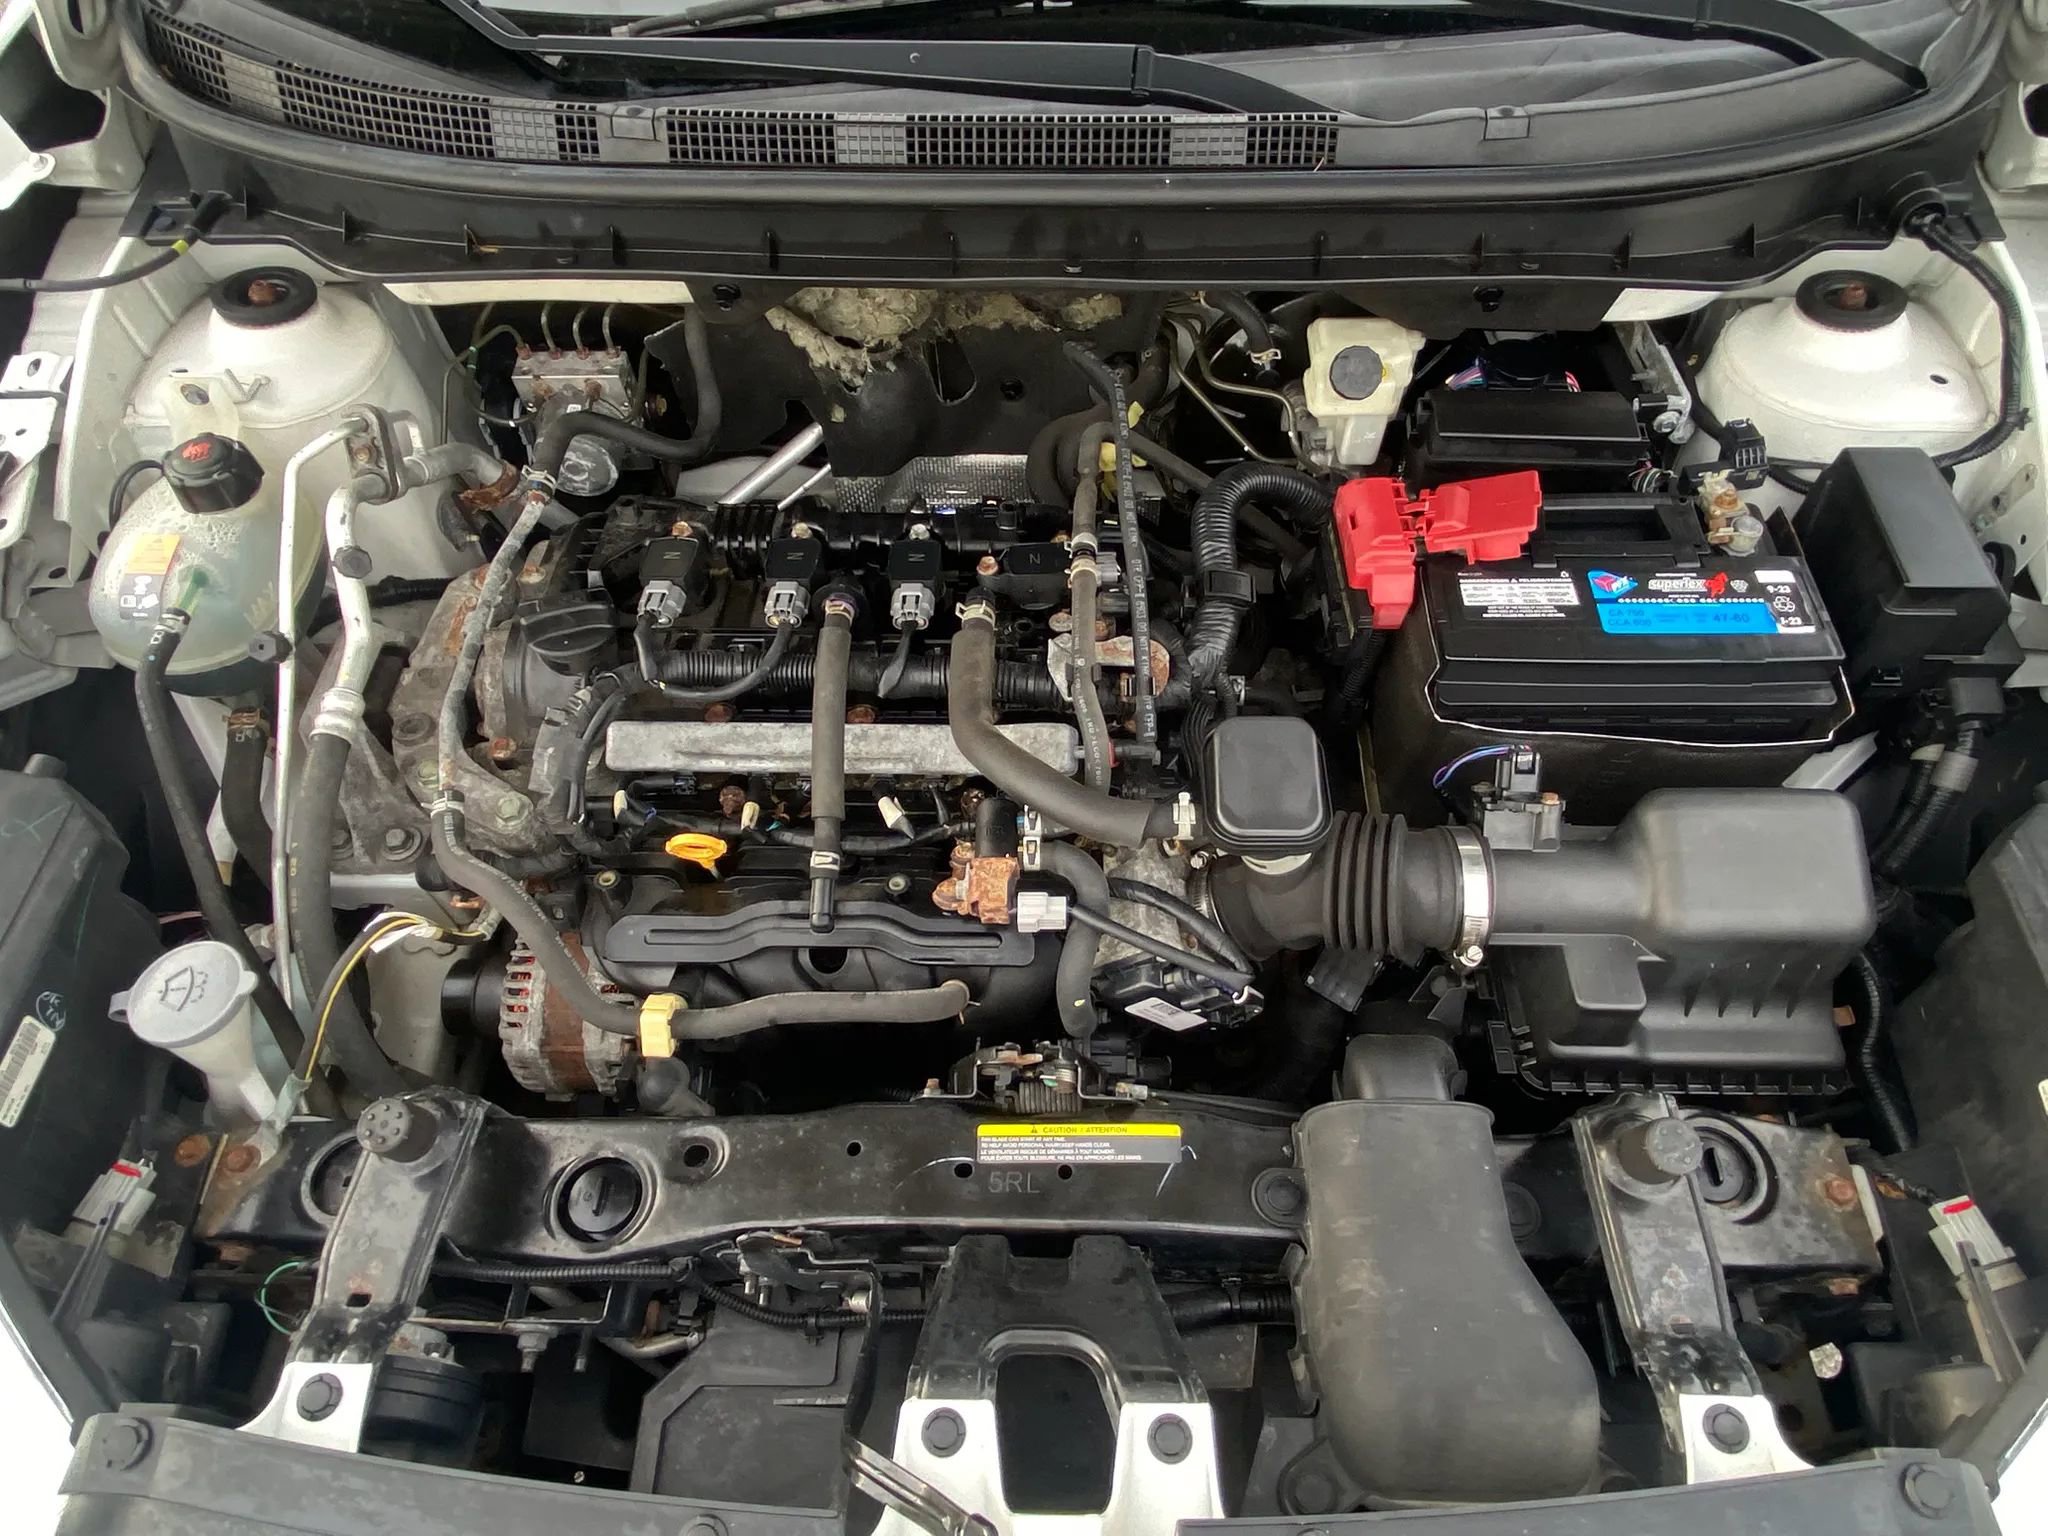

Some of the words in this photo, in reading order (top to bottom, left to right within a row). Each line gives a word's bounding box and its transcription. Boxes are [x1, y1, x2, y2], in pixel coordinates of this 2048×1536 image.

[1029, 552, 1041, 565] N
[1042, 1126, 1077, 1134] CAUTION
[988, 1171, 1040, 1193] 5RL
